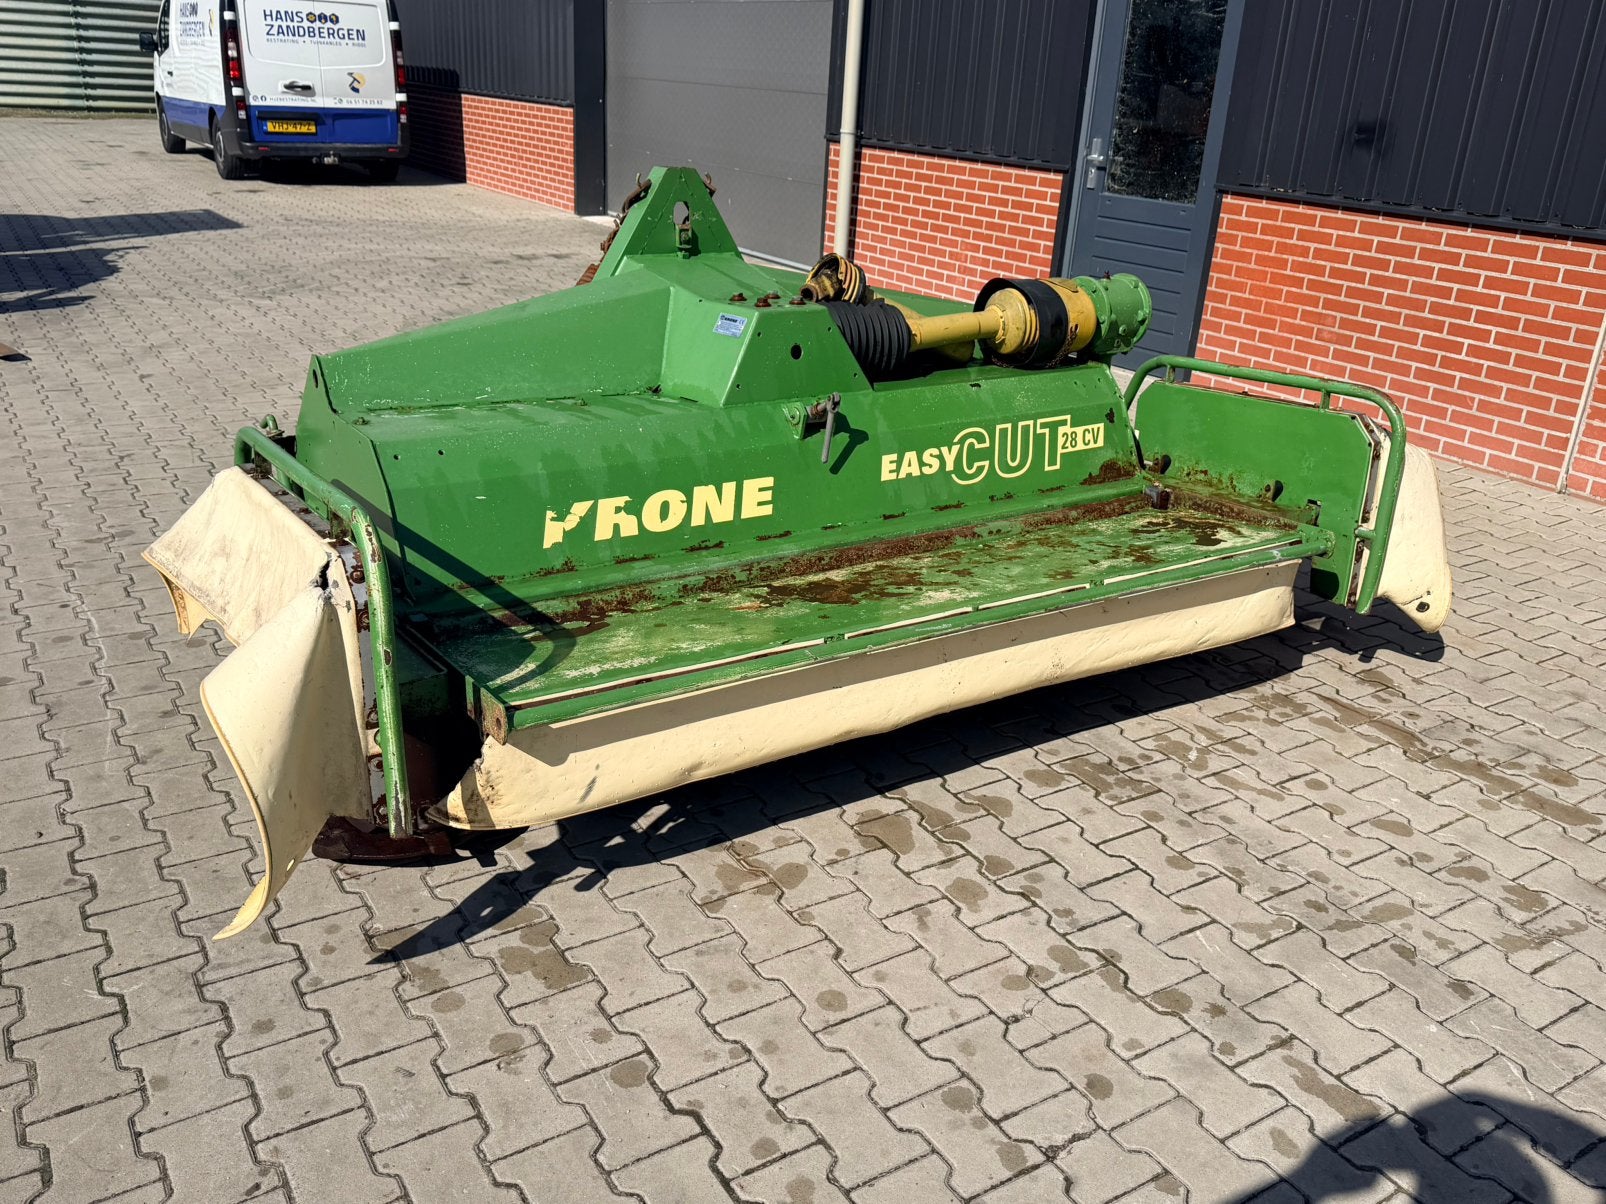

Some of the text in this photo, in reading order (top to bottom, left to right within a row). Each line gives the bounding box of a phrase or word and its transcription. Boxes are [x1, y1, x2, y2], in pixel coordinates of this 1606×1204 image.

[263, 9, 304, 23] HANS
[265, 24, 366, 41] ZANDBERGEN
[1061, 431, 1078, 450] 28
[1082, 427, 1101, 447] CV
